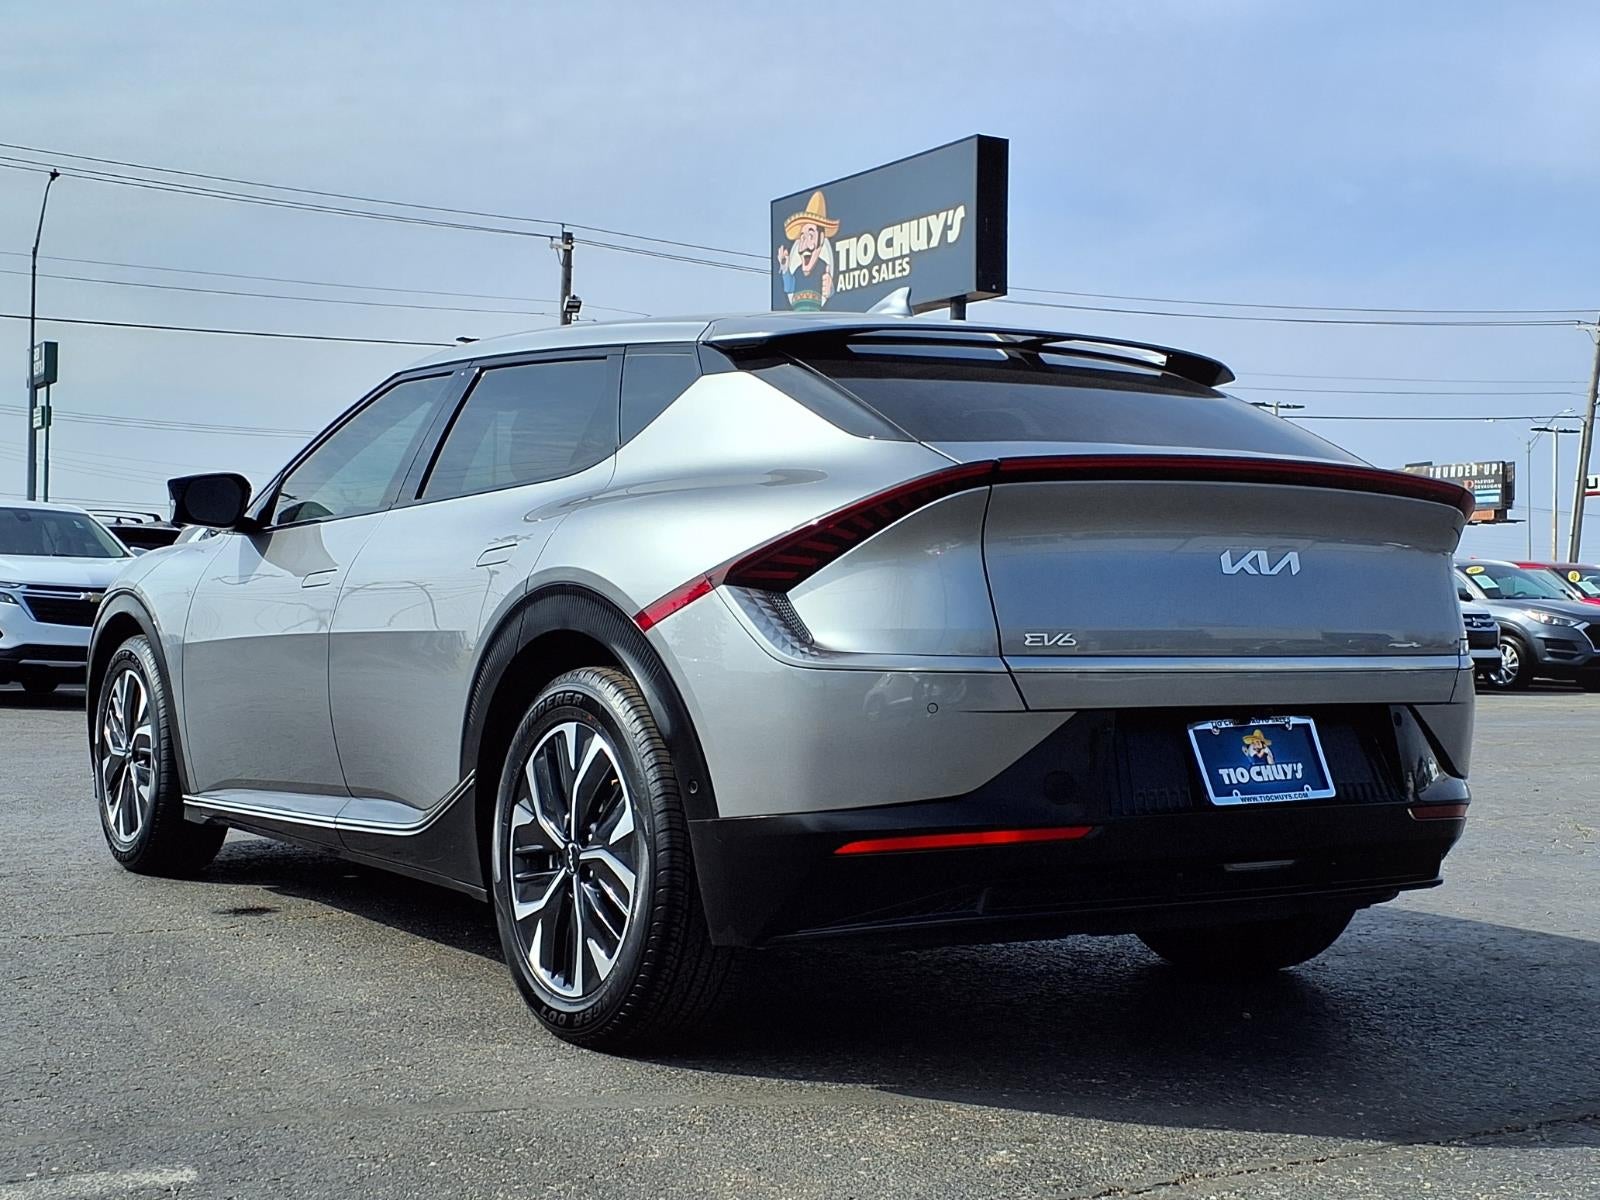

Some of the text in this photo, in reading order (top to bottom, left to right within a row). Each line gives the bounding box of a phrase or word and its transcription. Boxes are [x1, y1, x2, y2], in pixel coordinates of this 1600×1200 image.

[835, 205, 965, 271] TIO CHUY'S
[837, 257, 910, 292] AUTO SALES
[1429, 462, 1502, 478] THUNDER UP!
[1220, 549, 1300, 575] KIA
[1024, 632, 1076, 646] EV6
[1219, 762, 1303, 785] TIO CHUY'S
[1240, 792, 1309, 804] WWW.TIOCHUYS.COM
